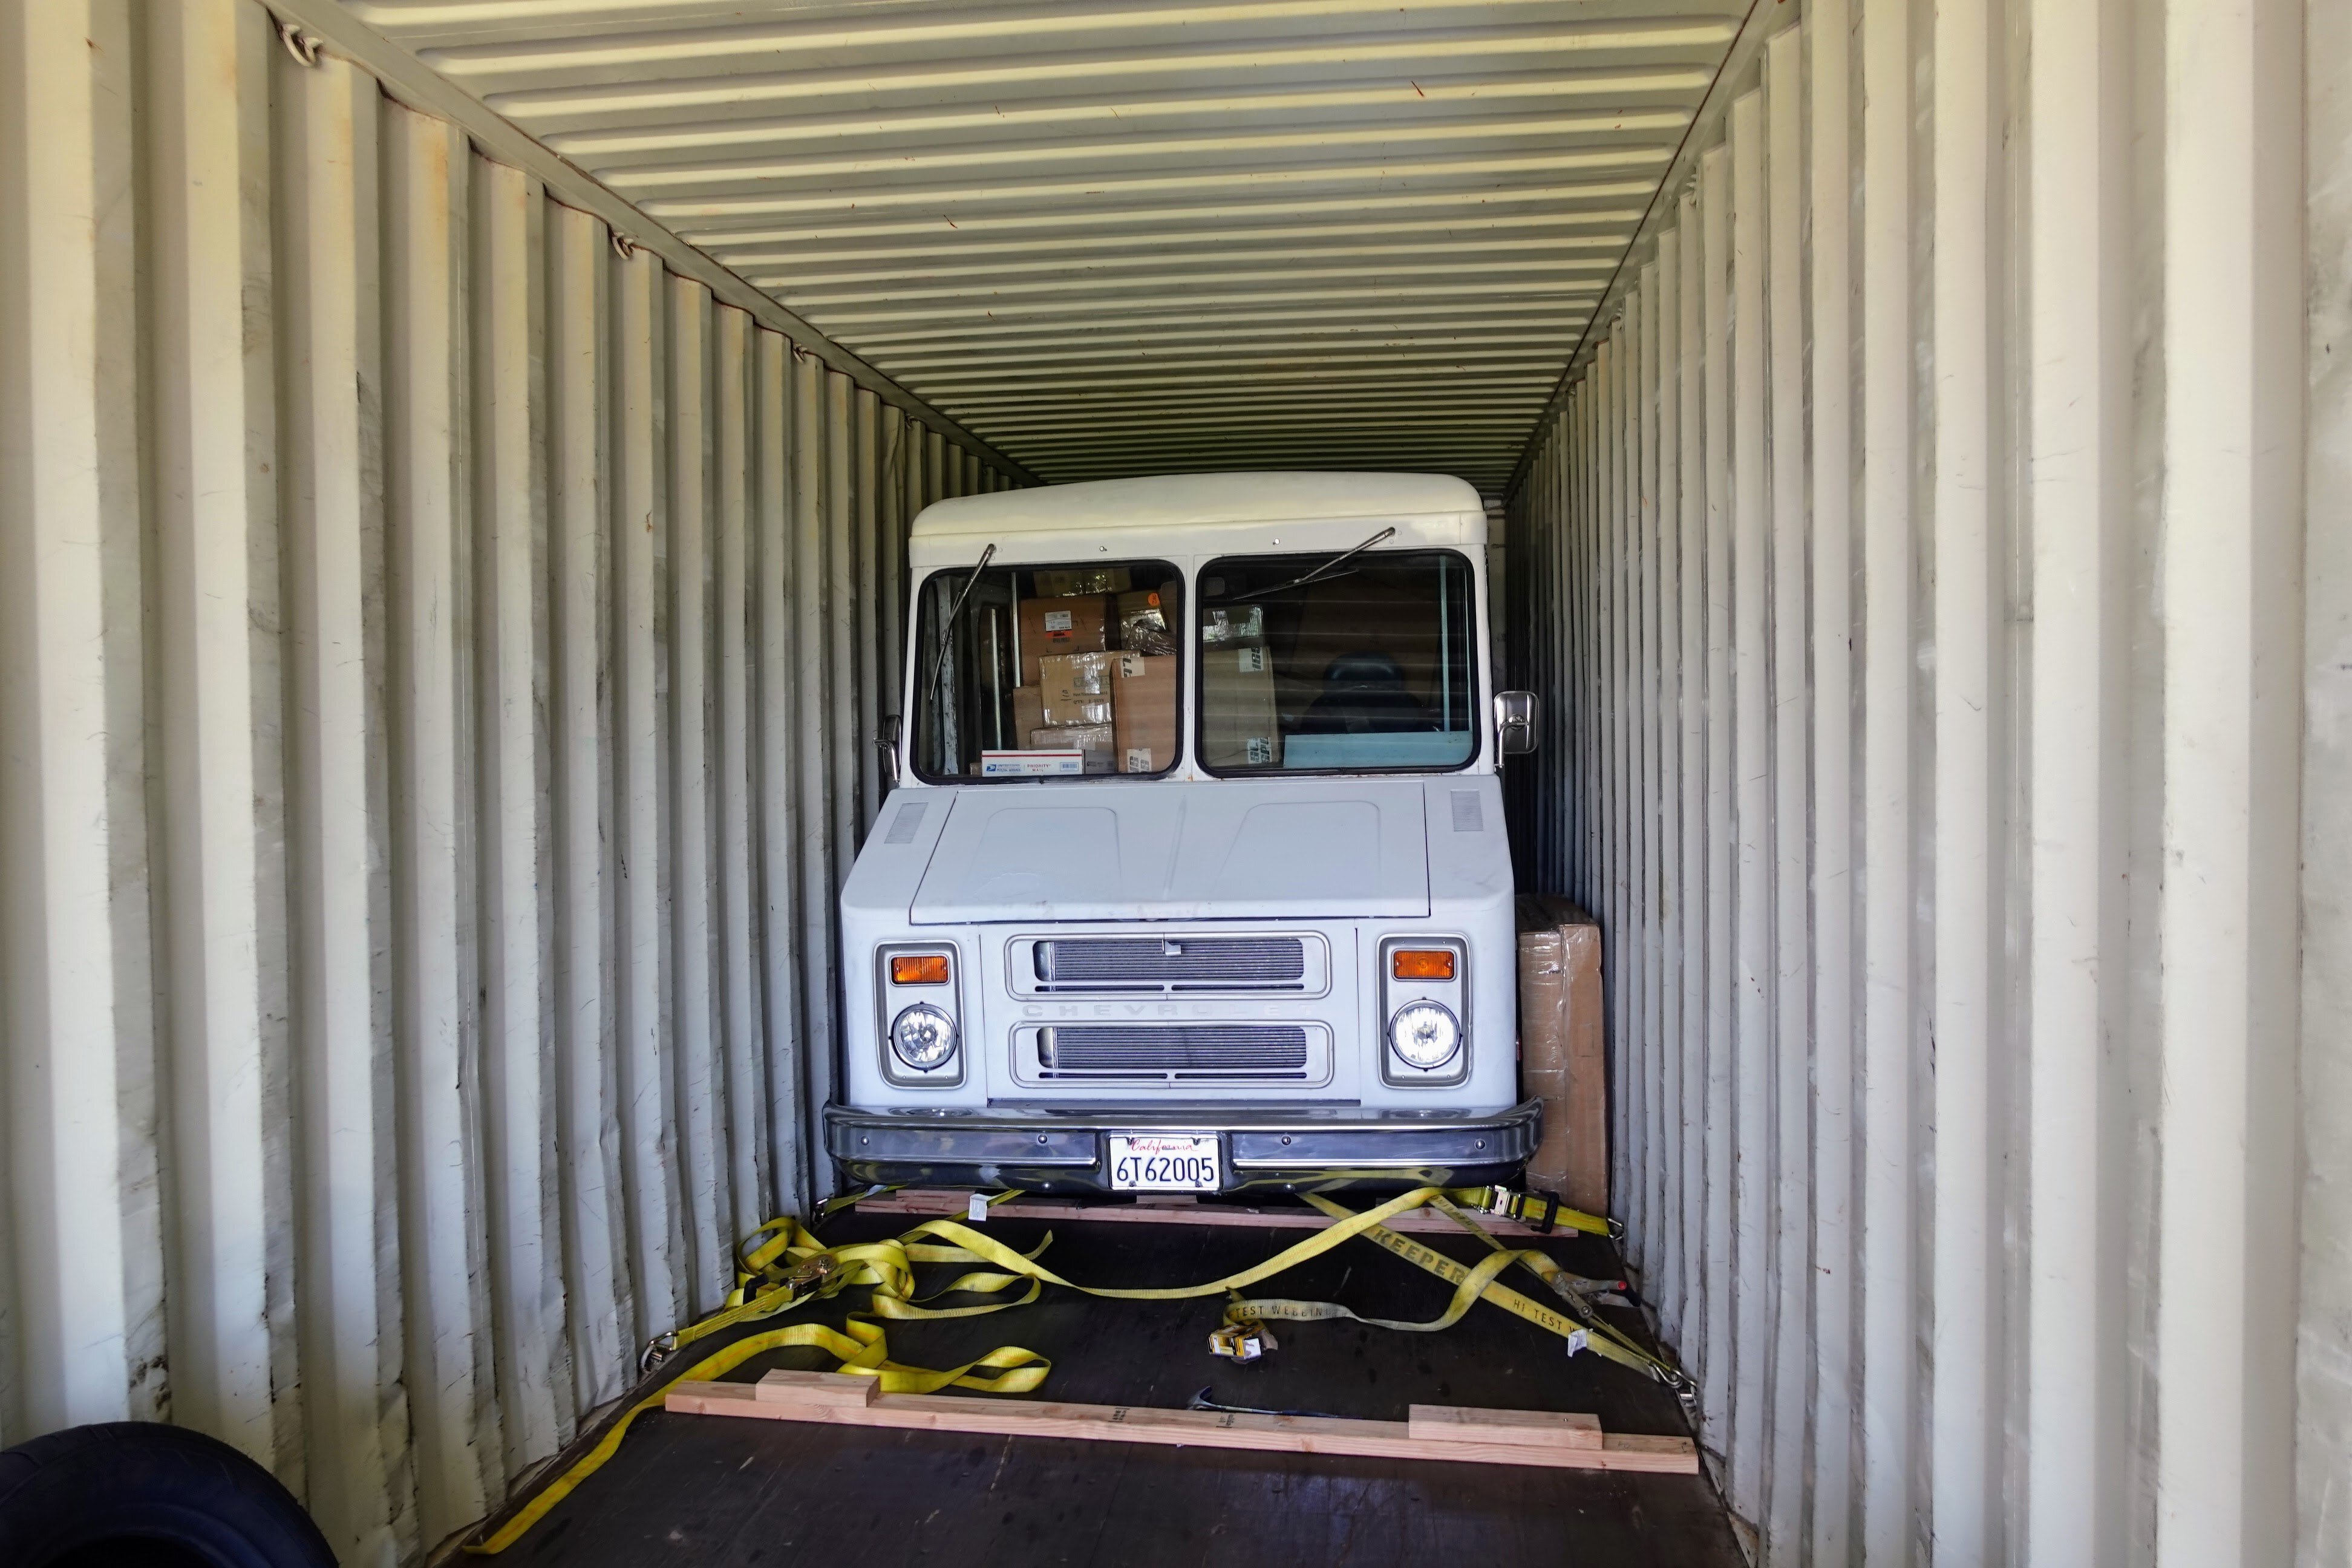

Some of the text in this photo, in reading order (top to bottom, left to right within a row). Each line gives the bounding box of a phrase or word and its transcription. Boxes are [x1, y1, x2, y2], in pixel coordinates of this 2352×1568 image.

[1022, 1004, 1318, 1018] CHEVROLET
[1131, 1138, 1200, 1155] California
[1117, 1157, 1214, 1182] 6T62005
[1373, 1229, 1466, 1284] KEEPER
[1235, 1305, 1264, 1318] TEST
